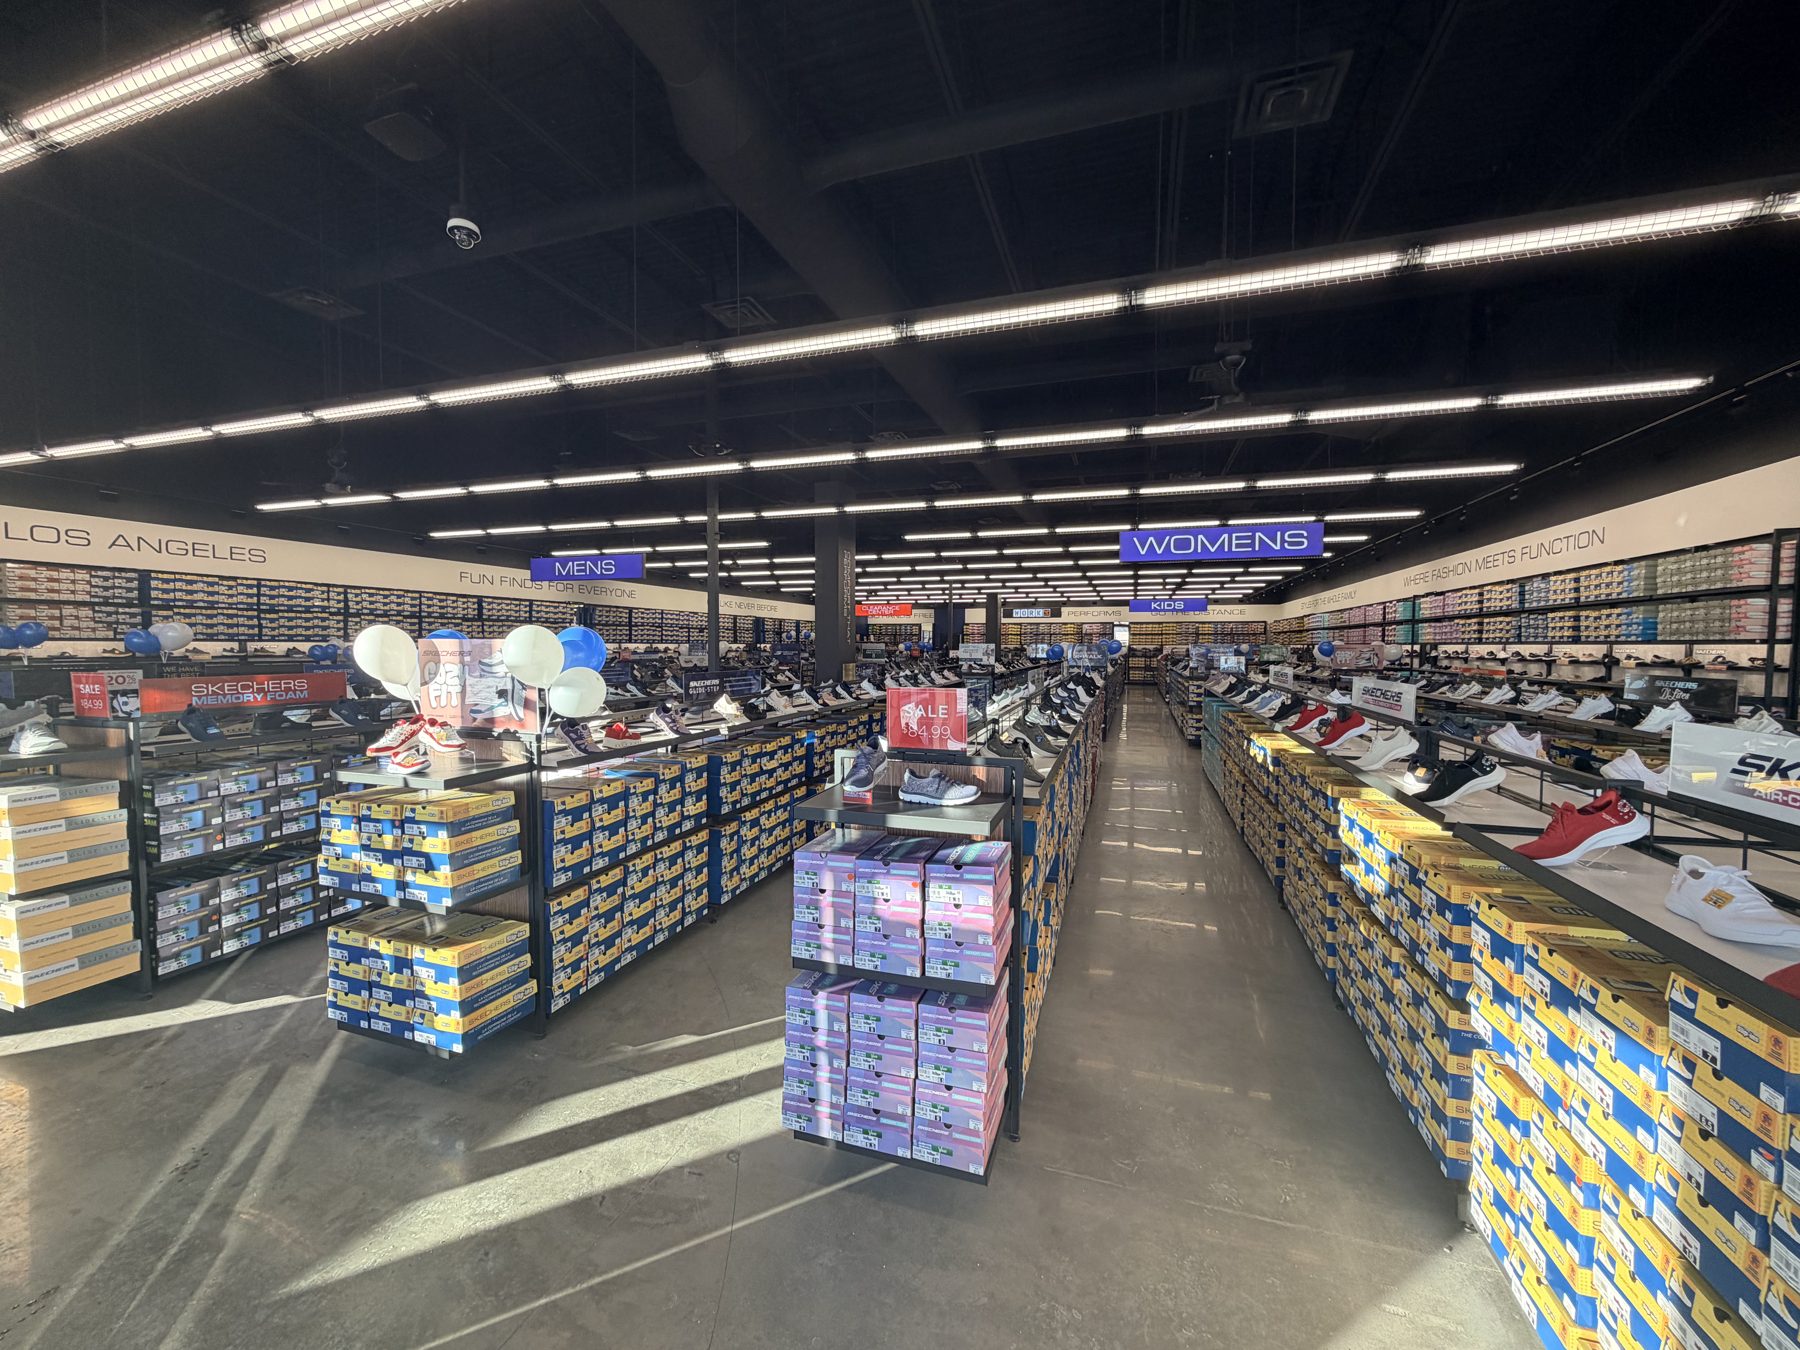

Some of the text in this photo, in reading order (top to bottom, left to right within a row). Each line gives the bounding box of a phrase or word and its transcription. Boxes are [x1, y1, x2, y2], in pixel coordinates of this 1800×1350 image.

[4, 521, 267, 564] LOS ANGELES
[1133, 530, 1308, 555] WOMENS
[1403, 527, 1606, 587] WHERE FASHION MEETS FUNCTION
[555, 560, 616, 576] MENS
[460, 571, 637, 599] FUN FINDS FOR EVERYONE
[734, 602, 756, 610] NEVER
[756, 604, 779, 612] BEFORE
[1014, 609, 1041, 617] WORK
[1151, 601, 1184, 610] KIDS
[423, 661, 466, 687] COZY
[79, 684, 101, 694] SALE
[191, 680, 308, 696] SKECHERS
[688, 685, 720, 695] GLIDE-STEP
[689, 679, 720, 687] SKECHERS
[1655, 680, 1699, 689] SKECHERS
[192, 691, 308, 706] MEMORY FOAM
[428, 682, 463, 709] FIT
[1361, 686, 1403, 702] SKECHERS
[80, 698, 103, 710] $84.99
[905, 705, 949, 718] SALE
[901, 725, 951, 739] $84.99
[1701, 1115, 1714, 1131] 6.5
